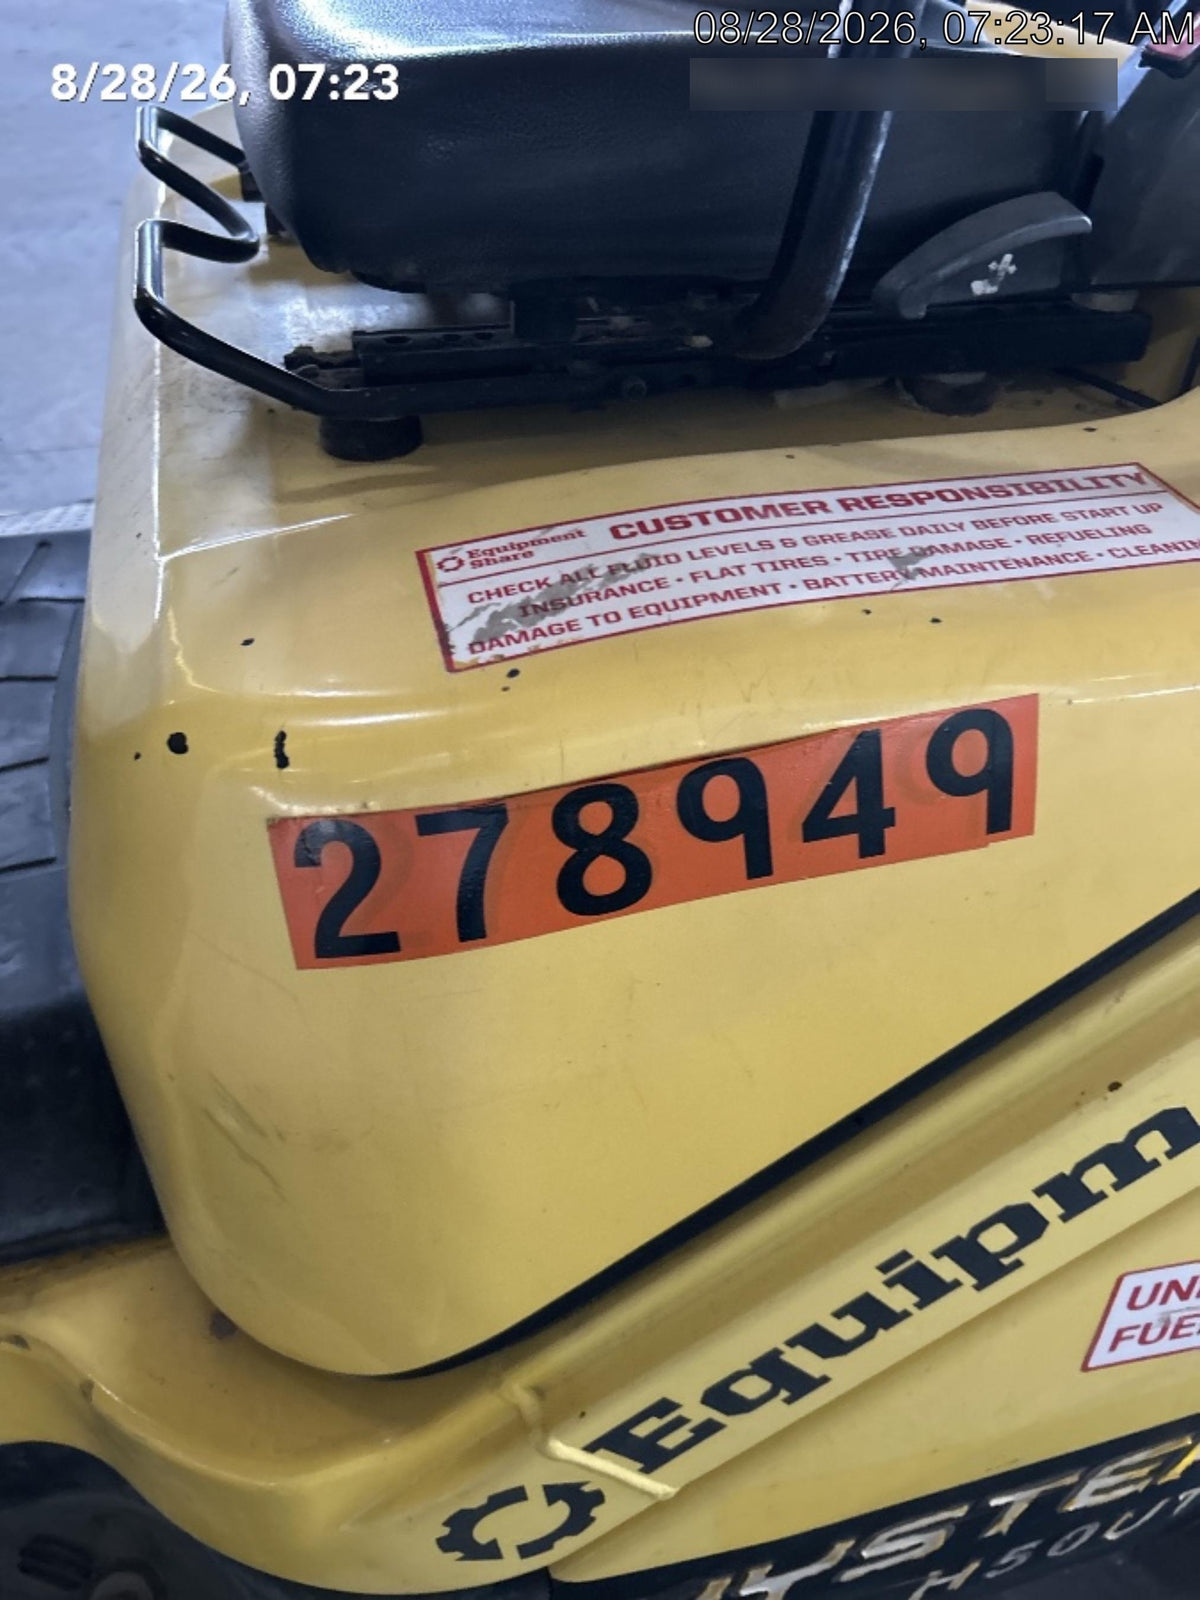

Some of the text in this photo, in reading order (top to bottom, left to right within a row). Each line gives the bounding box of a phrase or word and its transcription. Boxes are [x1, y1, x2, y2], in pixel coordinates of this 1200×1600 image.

[466, 529, 588, 560] Equipment
[610, 471, 1149, 541] CUSTOMER RESPONSIBILITY
[467, 502, 1164, 605] CHECK ALL FLUID LEVELS & GREASE DAILY BEFORE START UP
[469, 551, 535, 569] Share
[519, 523, 1153, 619] INSURANCE FLAT TIRES TIRE DAMAGE REFUELING
[467, 619, 583, 656] DAMAGE
[586, 609, 622, 628] TO
[628, 581, 783, 621] EQUIPMENT
[802, 567, 913, 591] BATTERY
[914, 549, 1094, 579] MAINTENANCE
[293, 706, 1015, 960] 278949
[581, 1106, 1200, 1474] Equipm
[1126, 1274, 1200, 1311] UN
[1108, 1312, 1200, 1353] FUE
